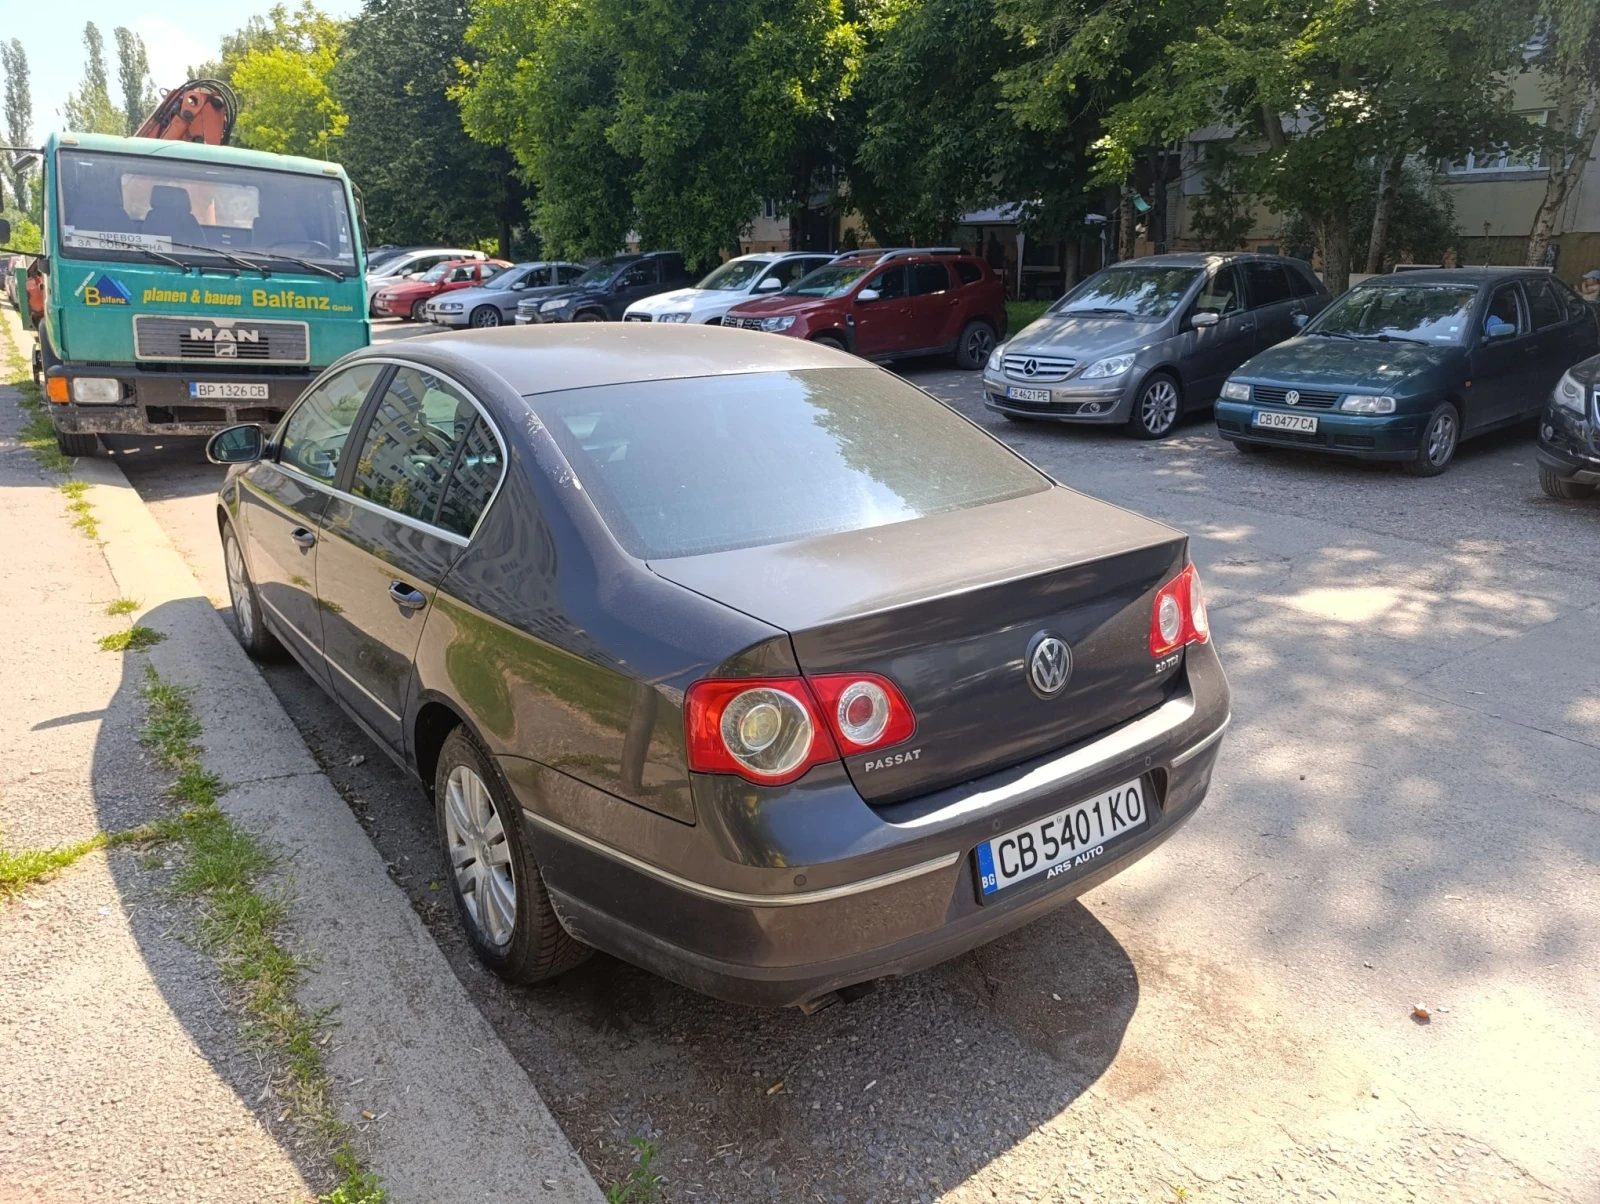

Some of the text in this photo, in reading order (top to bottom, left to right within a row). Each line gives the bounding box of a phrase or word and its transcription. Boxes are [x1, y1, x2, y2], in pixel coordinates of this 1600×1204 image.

[77, 239, 92, 248] ЗА
[99, 232, 142, 243] ПРЕВОЗ
[143, 287, 353, 312] planen & bauen Balfanz GmbH
[190, 327, 260, 342] MAN
[864, 748, 922, 773] PASSAT
[1046, 845, 1104, 880] ARS AUTO
[981, 873, 996, 889] BG
